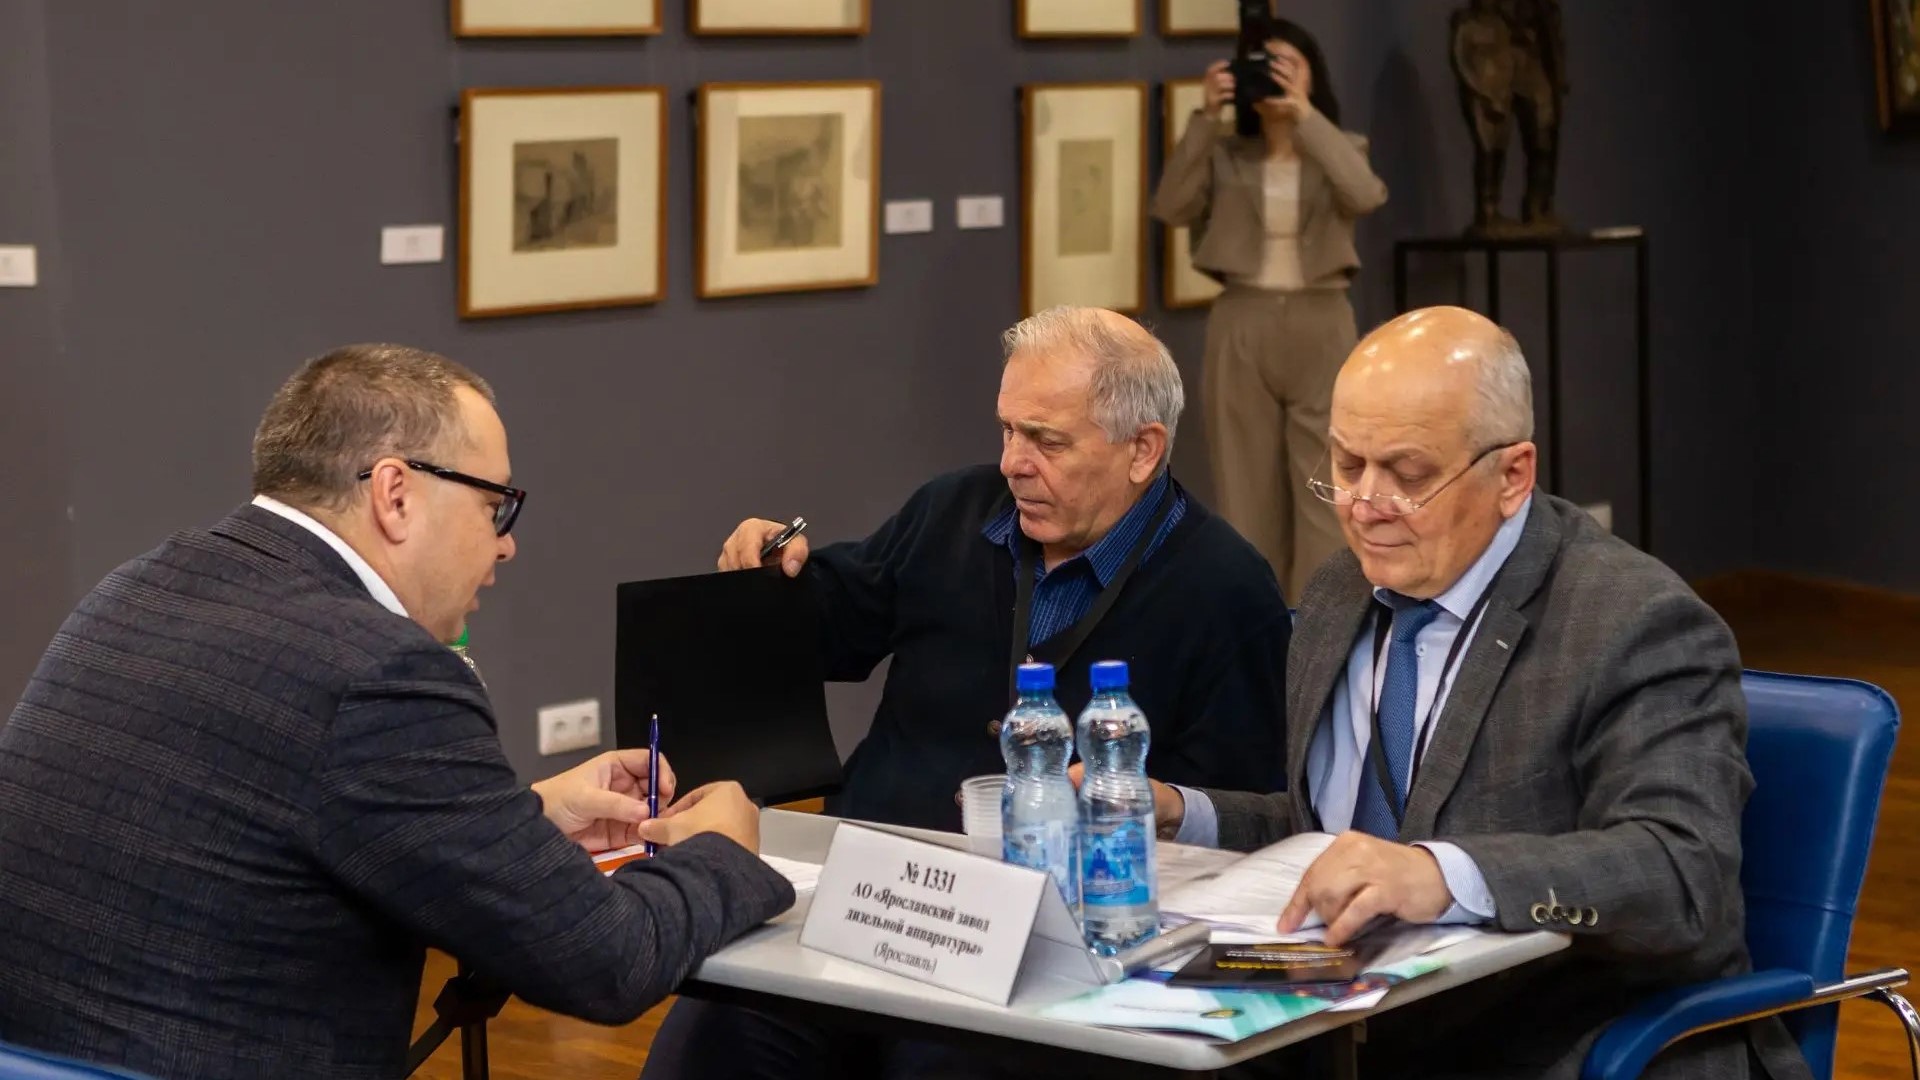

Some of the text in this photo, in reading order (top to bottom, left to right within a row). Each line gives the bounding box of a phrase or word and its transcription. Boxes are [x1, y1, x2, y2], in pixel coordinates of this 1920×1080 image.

[900, 861, 956, 894] № 1331
[852, 882, 990, 933] АО «Ярославский завод
[845, 908, 983, 956] дизельной аппаратуры»
[873, 942, 938, 975] (Ярославль)
